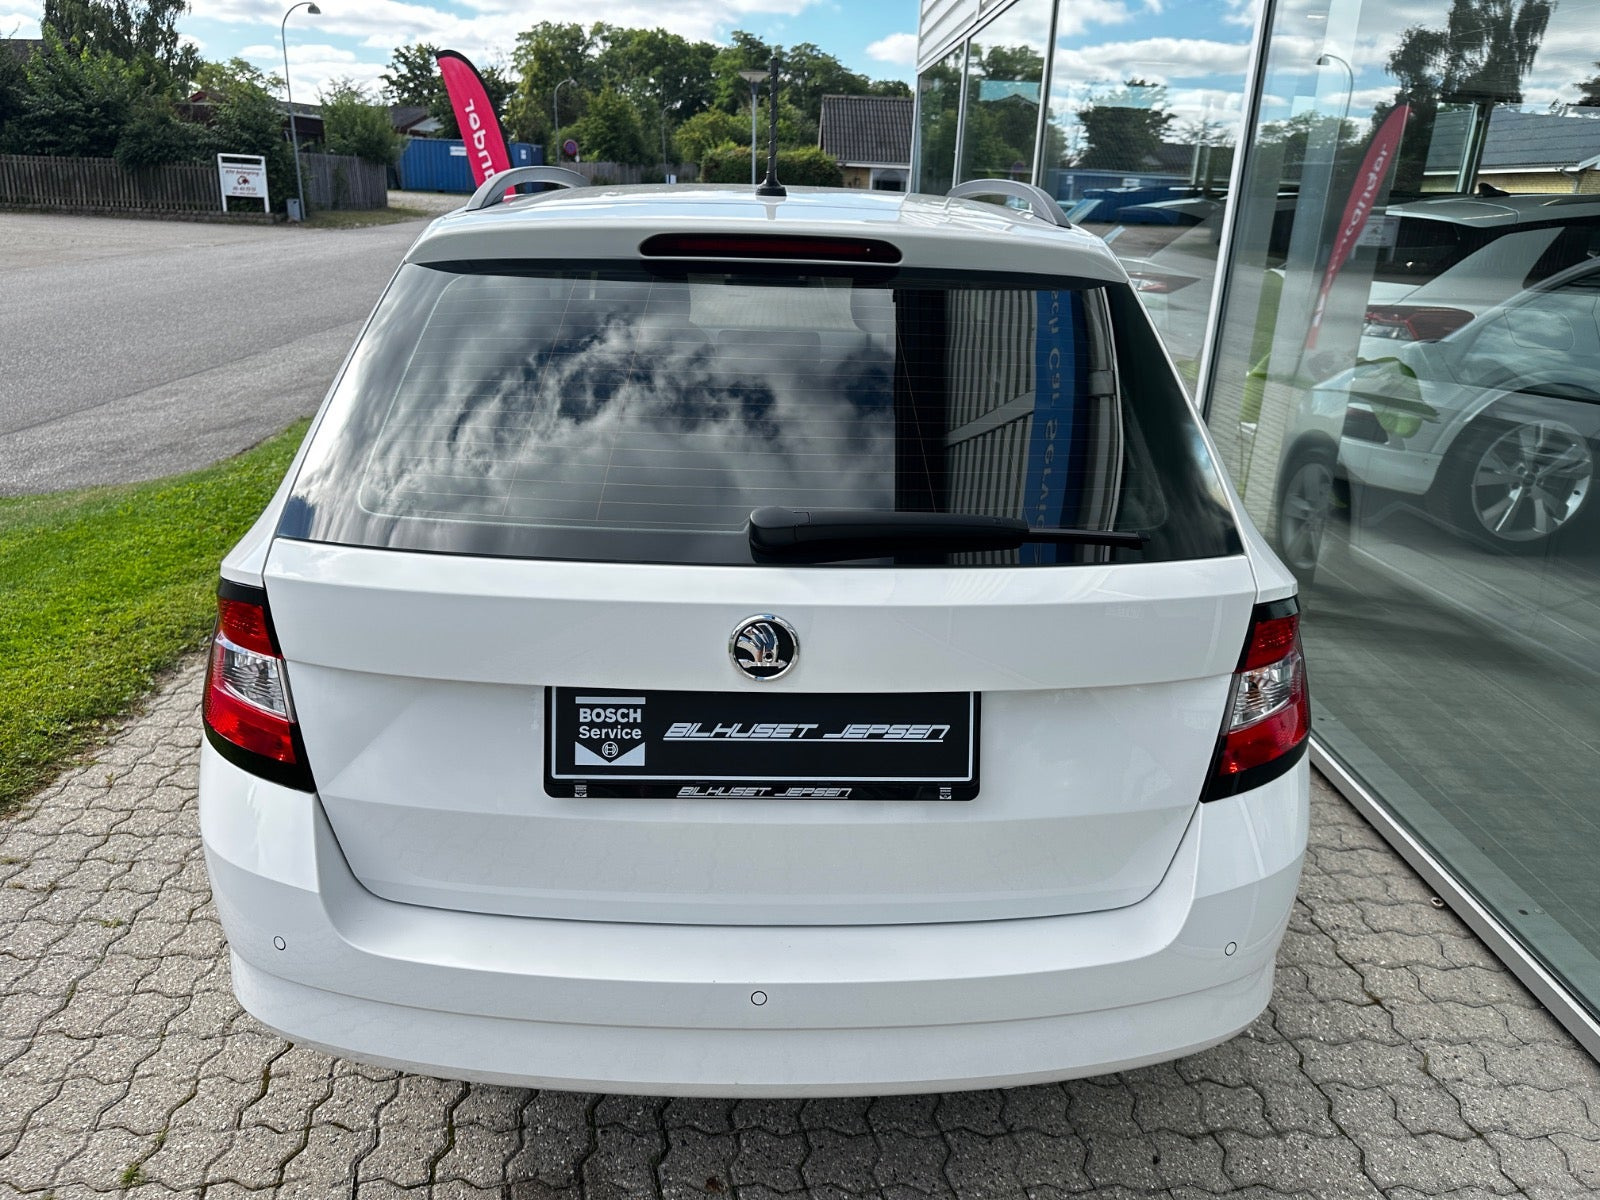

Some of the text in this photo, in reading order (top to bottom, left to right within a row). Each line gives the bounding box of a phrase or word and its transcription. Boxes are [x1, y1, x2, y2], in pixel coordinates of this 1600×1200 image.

[579, 708, 642, 723] BOSCH
[578, 725, 642, 739] Service
[664, 722, 951, 739] BILHUSET JEPSEN
[677, 786, 852, 797] BILHUSET JEPSEN
